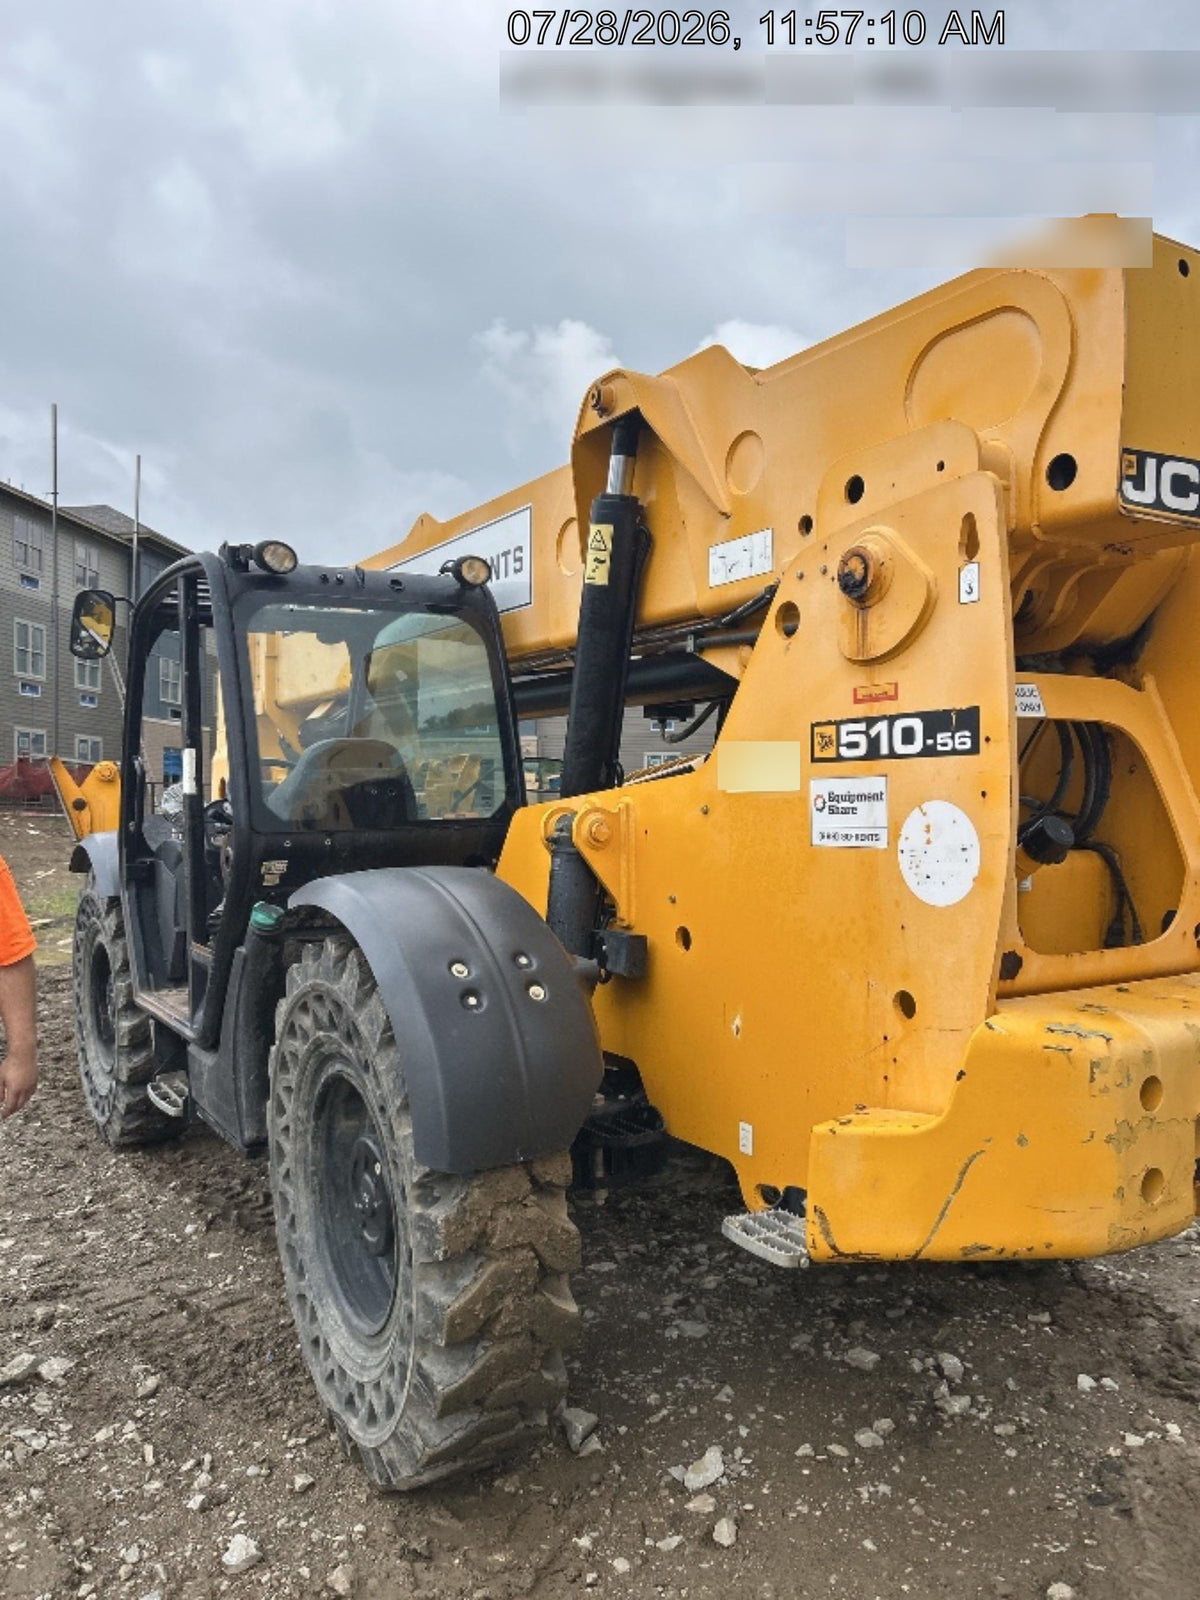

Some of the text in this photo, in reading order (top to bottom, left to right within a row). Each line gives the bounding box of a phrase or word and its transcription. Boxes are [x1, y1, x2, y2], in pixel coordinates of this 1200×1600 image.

[485, 545, 524, 583] NTS
[838, 717, 972, 758] 510-56
[827, 790, 884, 804] Equipment
[828, 804, 858, 815] Share
